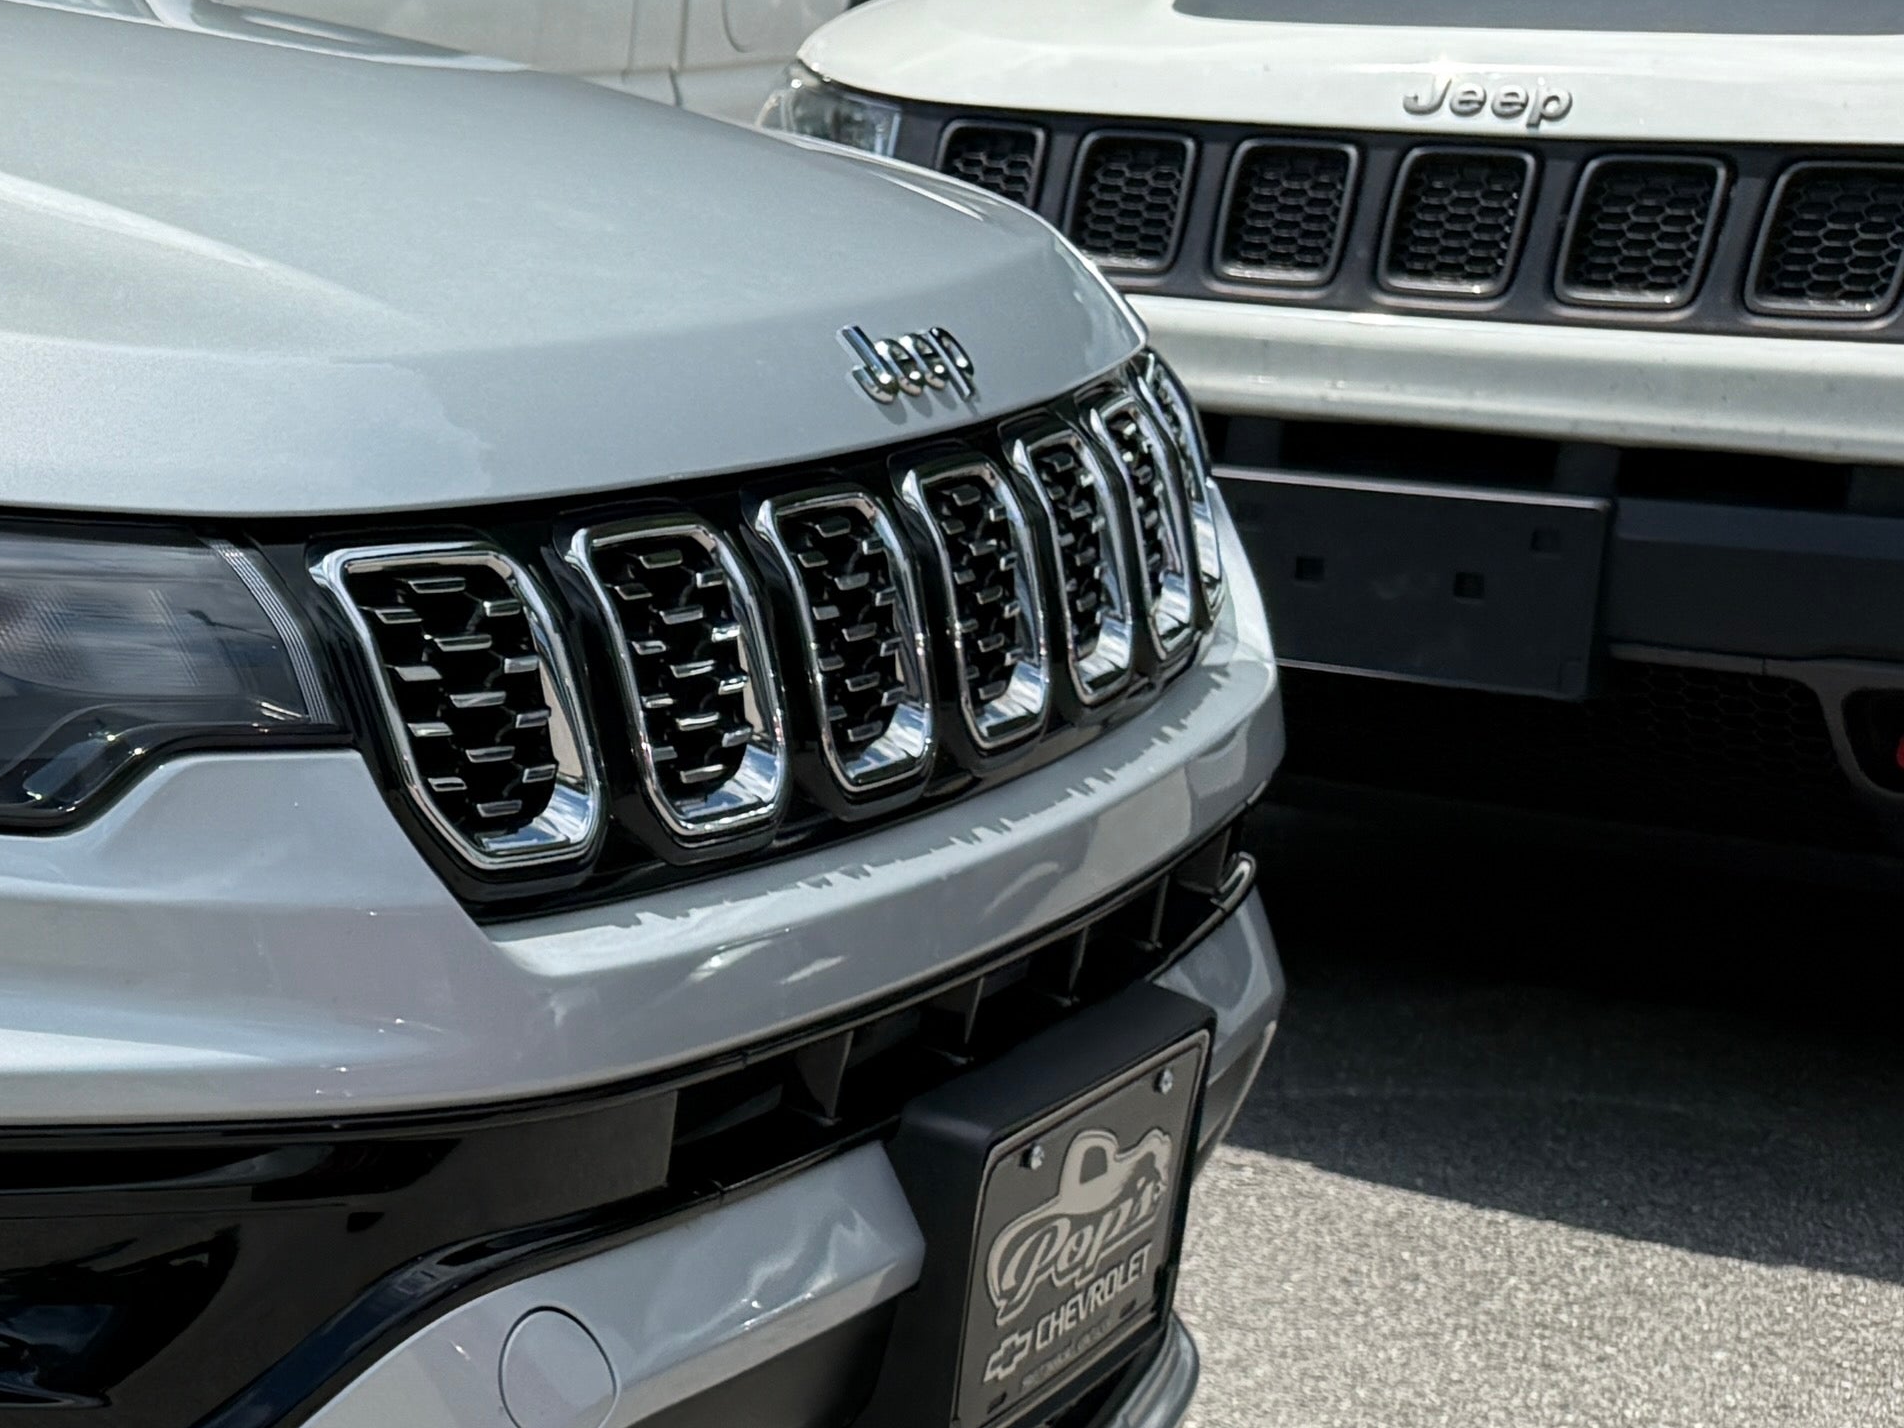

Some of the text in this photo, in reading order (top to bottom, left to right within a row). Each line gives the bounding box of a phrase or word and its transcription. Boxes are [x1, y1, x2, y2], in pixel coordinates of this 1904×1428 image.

[1402, 71, 1573, 129] Jeep
[835, 323, 975, 405] Jeep
[1035, 1242, 1153, 1352] CHEVROLET
